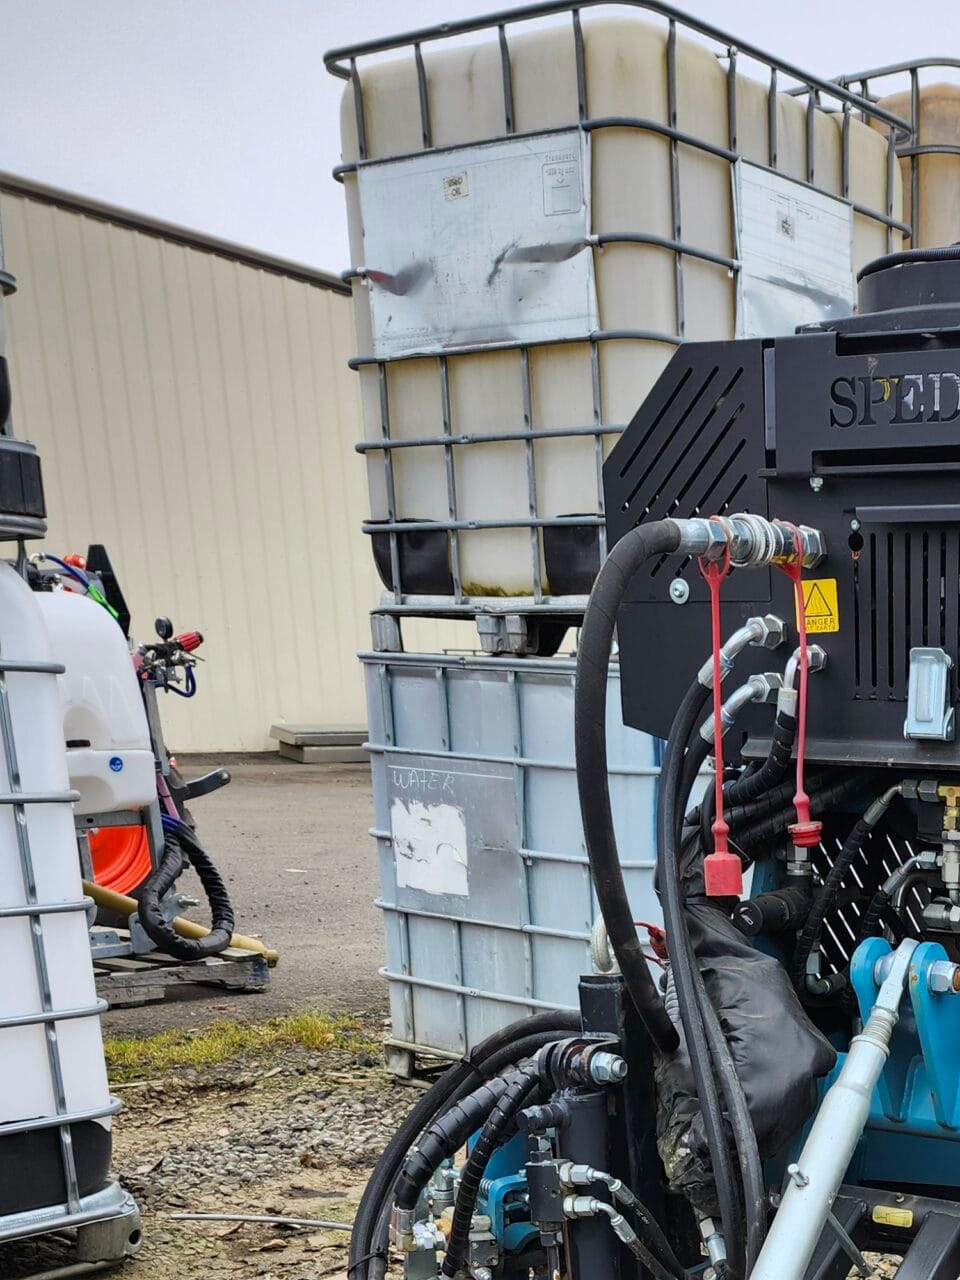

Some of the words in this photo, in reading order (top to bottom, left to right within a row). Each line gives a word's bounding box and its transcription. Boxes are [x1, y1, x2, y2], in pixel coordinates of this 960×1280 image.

[451, 187, 462, 197] OIL
[806, 617, 835, 626] ANGER
[393, 769, 456, 798] WATER
